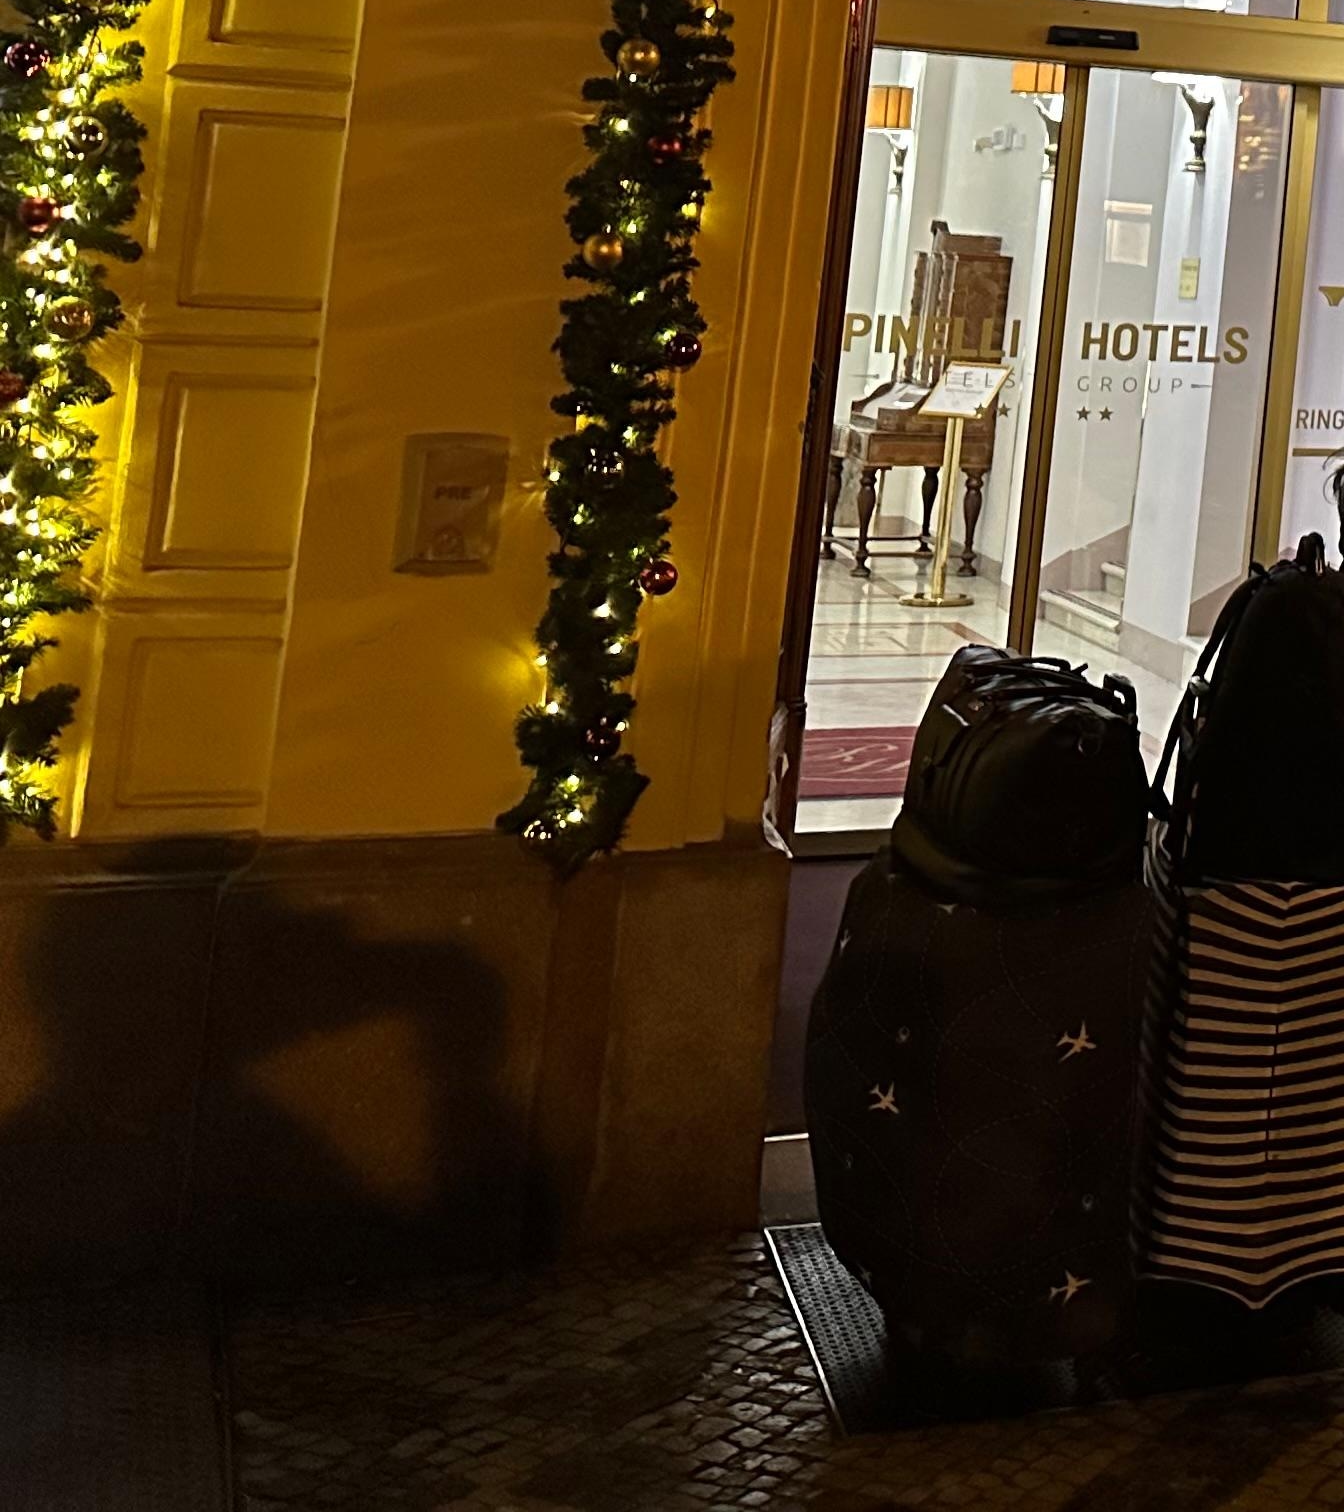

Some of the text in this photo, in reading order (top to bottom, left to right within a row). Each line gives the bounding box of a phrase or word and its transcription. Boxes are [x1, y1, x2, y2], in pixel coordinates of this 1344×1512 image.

[843, 312, 1249, 364] PINELLI HOTELS
[1077, 376, 1183, 394] GROUP
